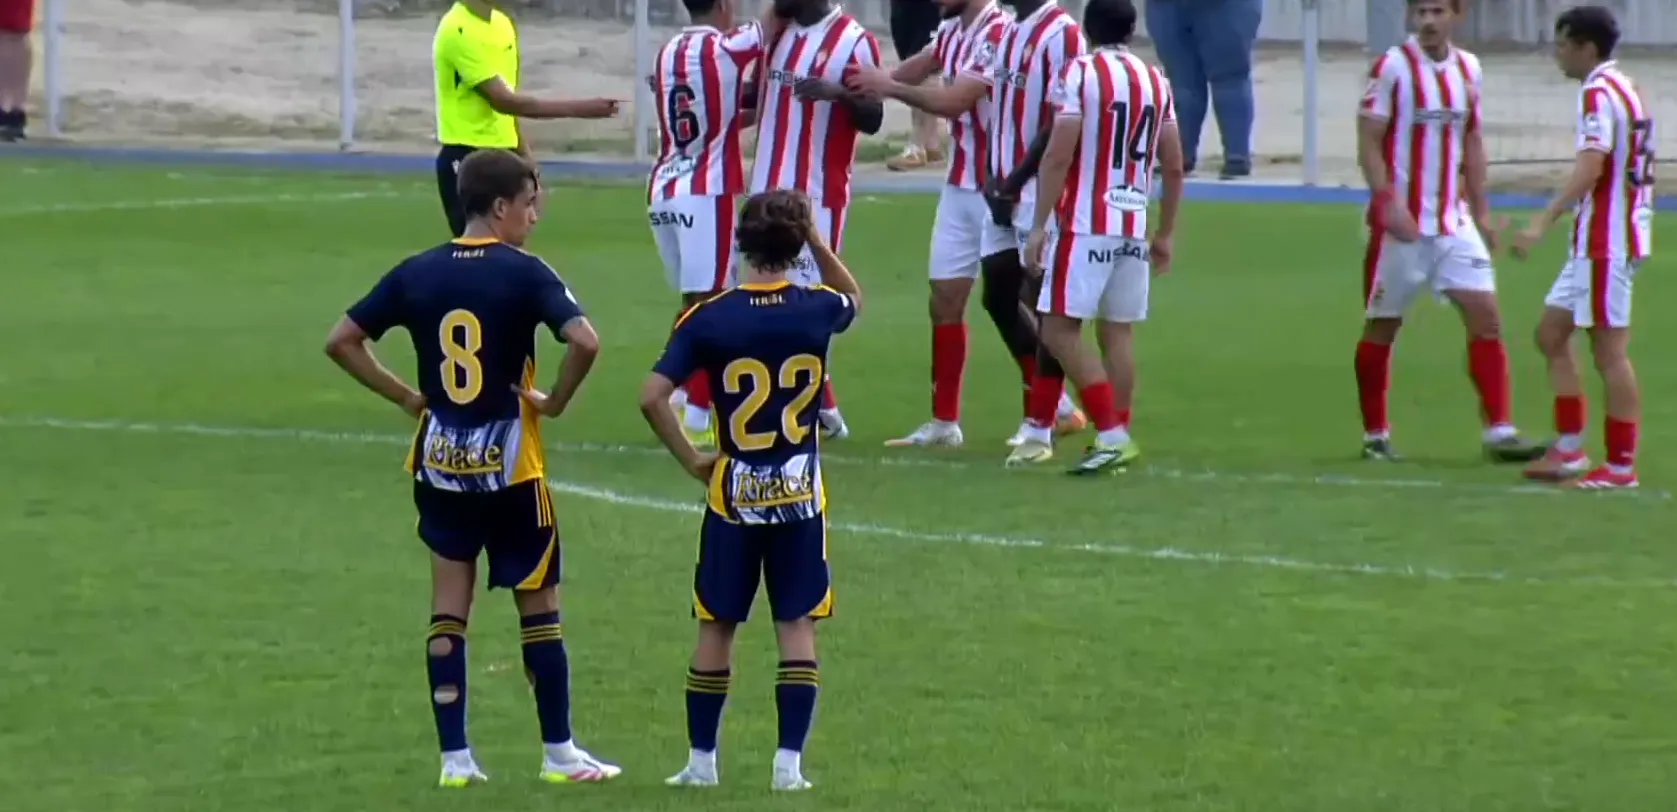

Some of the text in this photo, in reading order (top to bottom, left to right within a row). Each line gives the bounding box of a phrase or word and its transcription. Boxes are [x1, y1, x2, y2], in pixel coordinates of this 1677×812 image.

[669, 83, 699, 149] 6
[1108, 101, 1156, 170] 14
[438, 308, 483, 405] 8
[722, 353, 822, 452] 22
